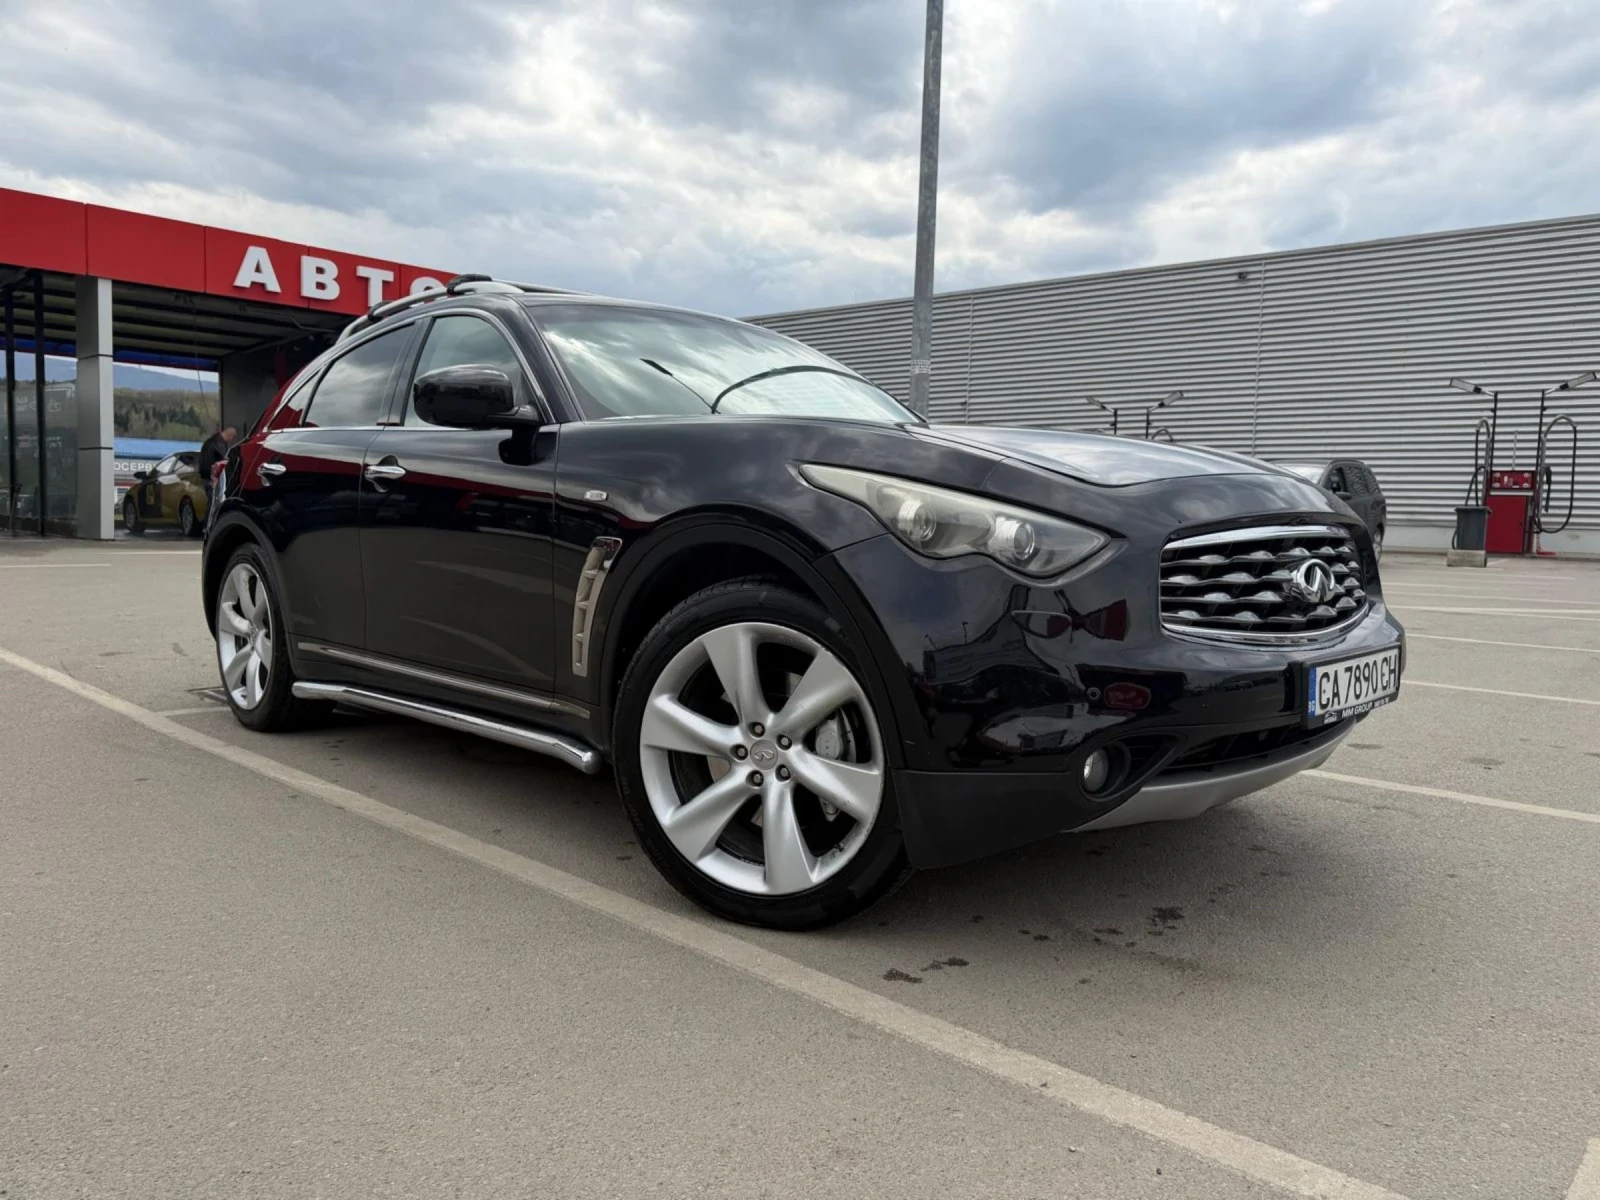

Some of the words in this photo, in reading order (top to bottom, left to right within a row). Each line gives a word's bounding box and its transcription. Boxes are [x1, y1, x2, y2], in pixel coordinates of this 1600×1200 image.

[1319, 669, 1341, 710] CA
[1344, 659, 1378, 704] 7890
[1380, 654, 1397, 691] CH
[1341, 707, 1354, 718] MM
[1354, 702, 1373, 714] GROUP
